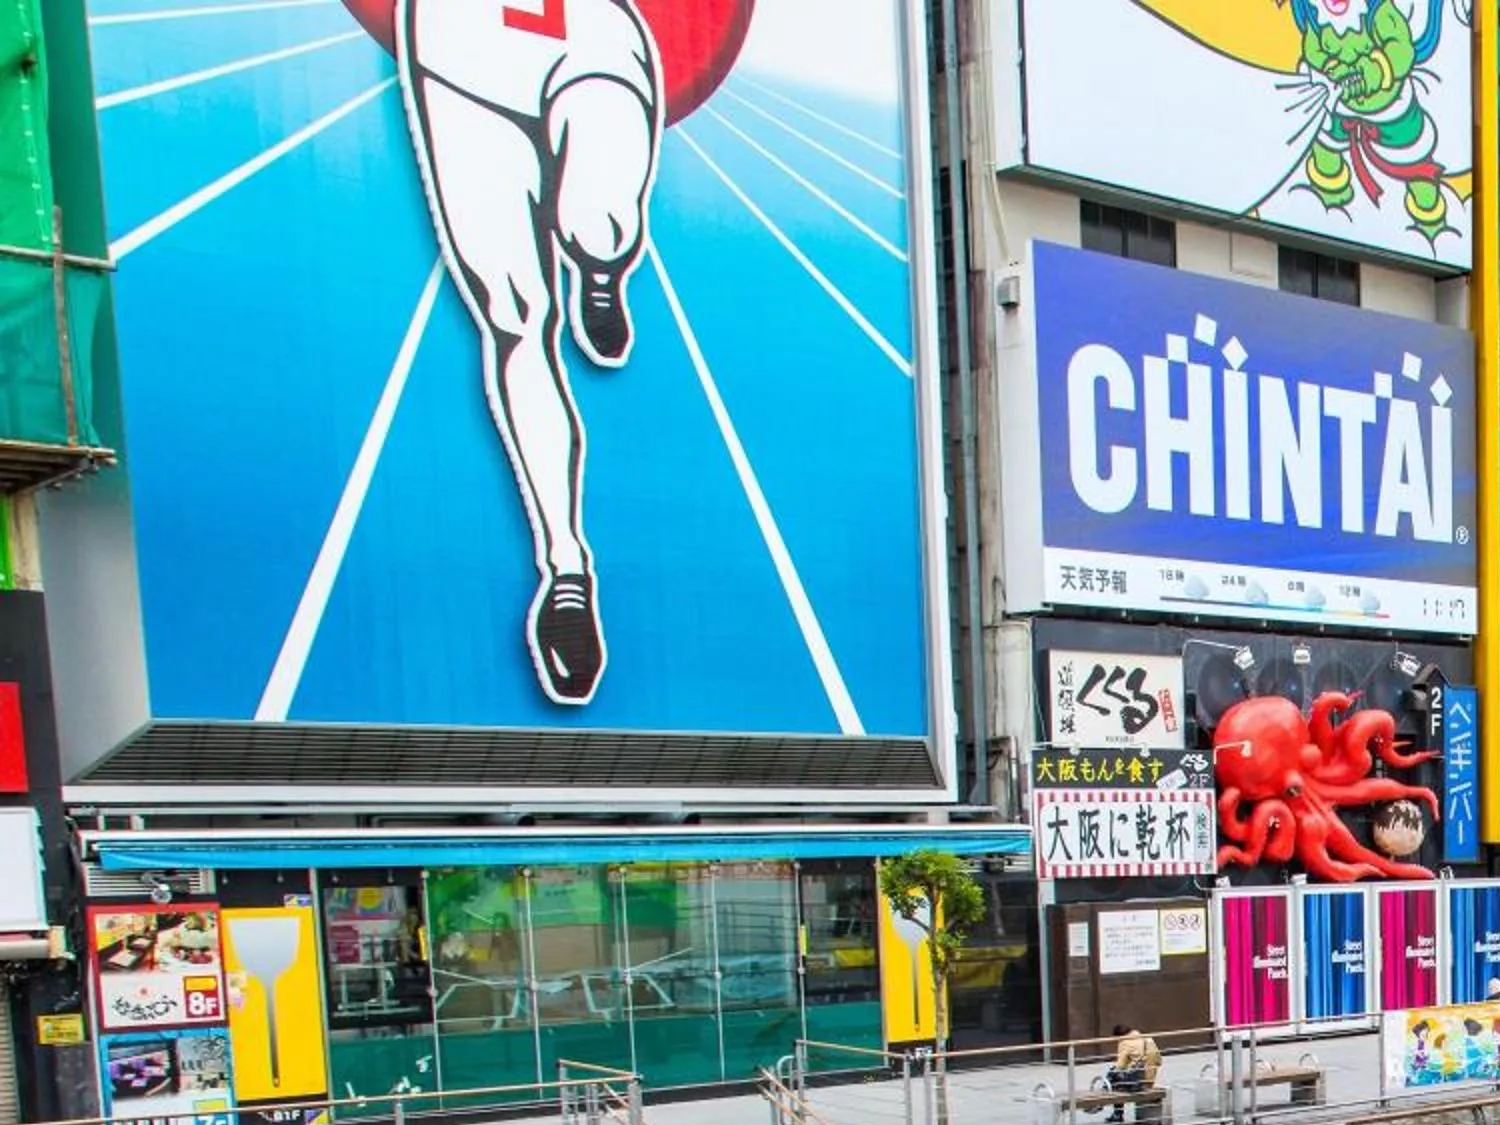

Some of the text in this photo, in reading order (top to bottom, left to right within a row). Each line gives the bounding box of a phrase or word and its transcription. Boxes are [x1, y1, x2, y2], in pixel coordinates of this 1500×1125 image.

[1060, 564, 1128, 594] 天気予報
[1076, 663, 1158, 735] くくる
[1431, 687, 1442, 736] 2F
[1037, 757, 1164, 783] 大阪もんを食す
[1189, 774, 1210, 787] 2F
[1450, 702, 1473, 845] ペンギンバー
[1047, 804, 1191, 862] 大阪に乾杯
[189, 995, 218, 1015] 8F
